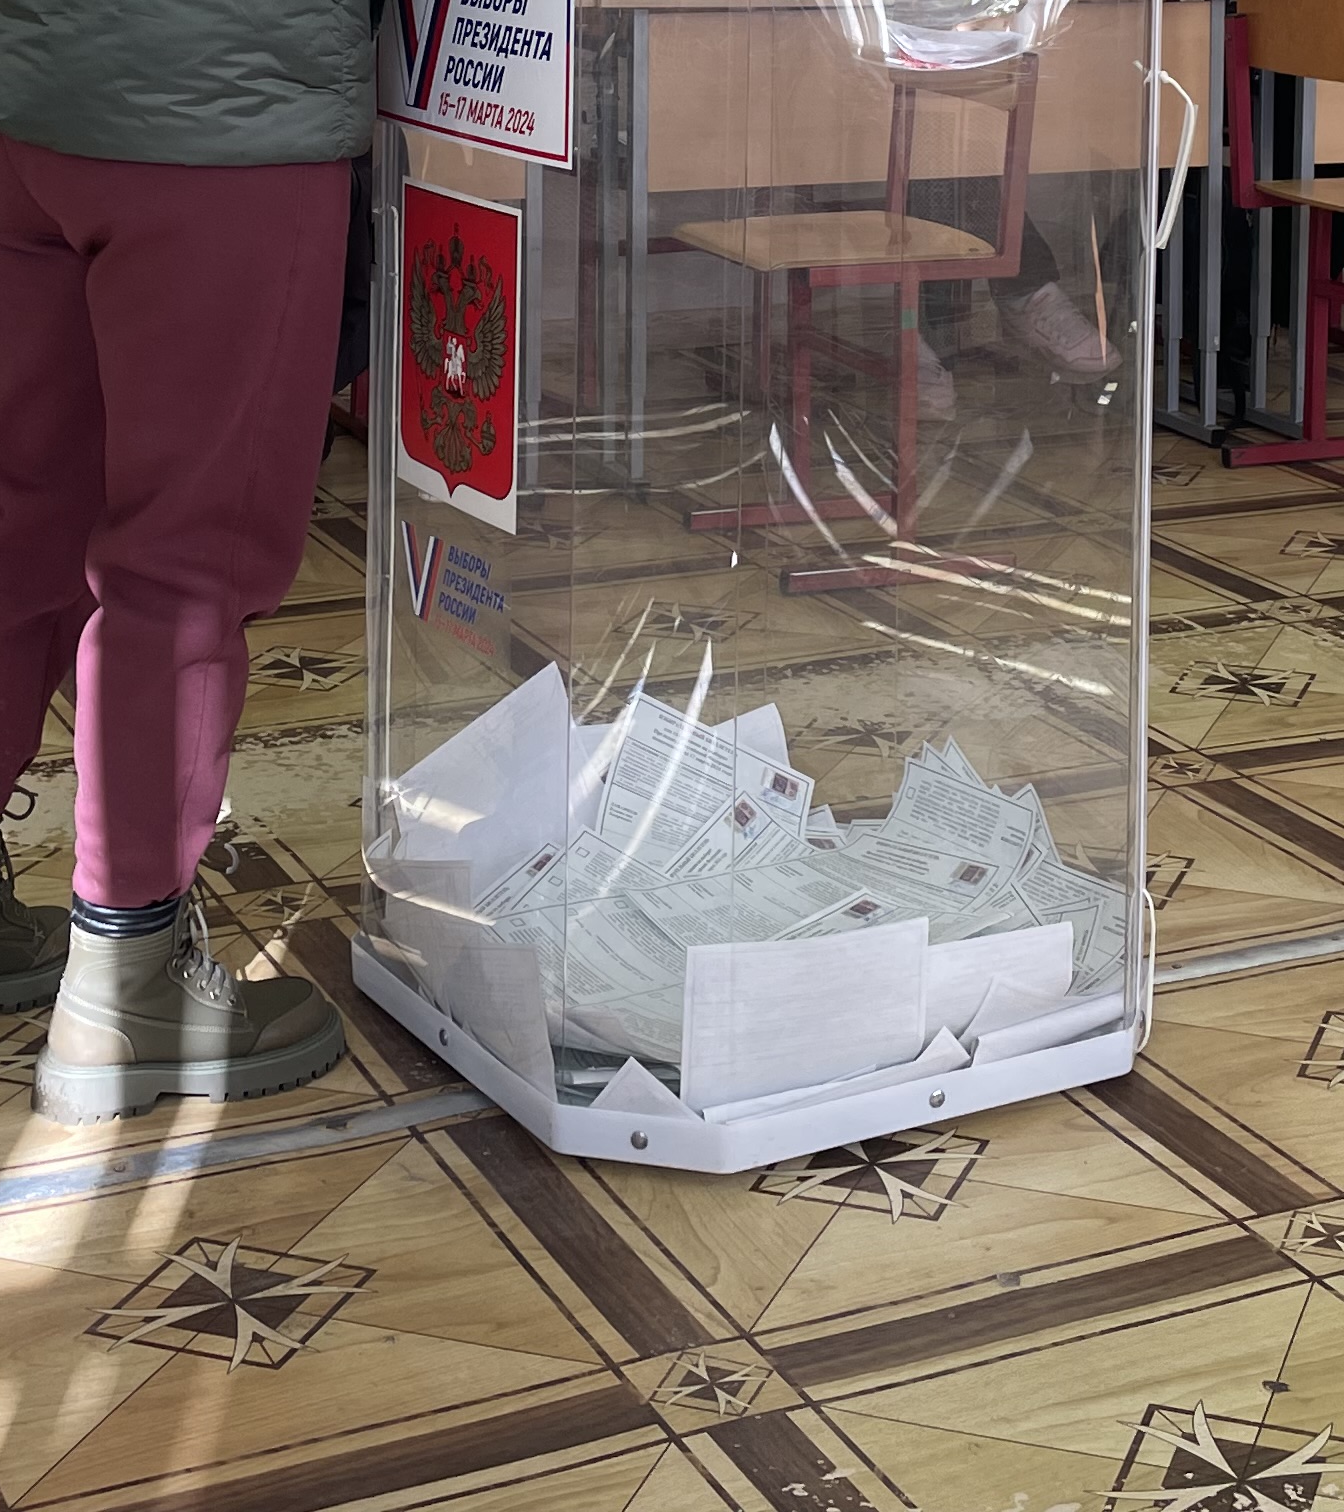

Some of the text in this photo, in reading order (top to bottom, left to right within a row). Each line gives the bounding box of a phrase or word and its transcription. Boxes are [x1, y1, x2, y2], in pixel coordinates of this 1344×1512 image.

[452, 17, 554, 62] ПРЕЗИДЕНТА
[444, 55, 506, 94] РОССИИ
[466, 99, 505, 130] МАРТА
[505, 108, 536, 137] 2024
[448, 546, 492, 581] ВЫБОРЫ
[438, 592, 477, 624] РОССИИ
[443, 568, 505, 613] ПРЕЗИДЕНТА
